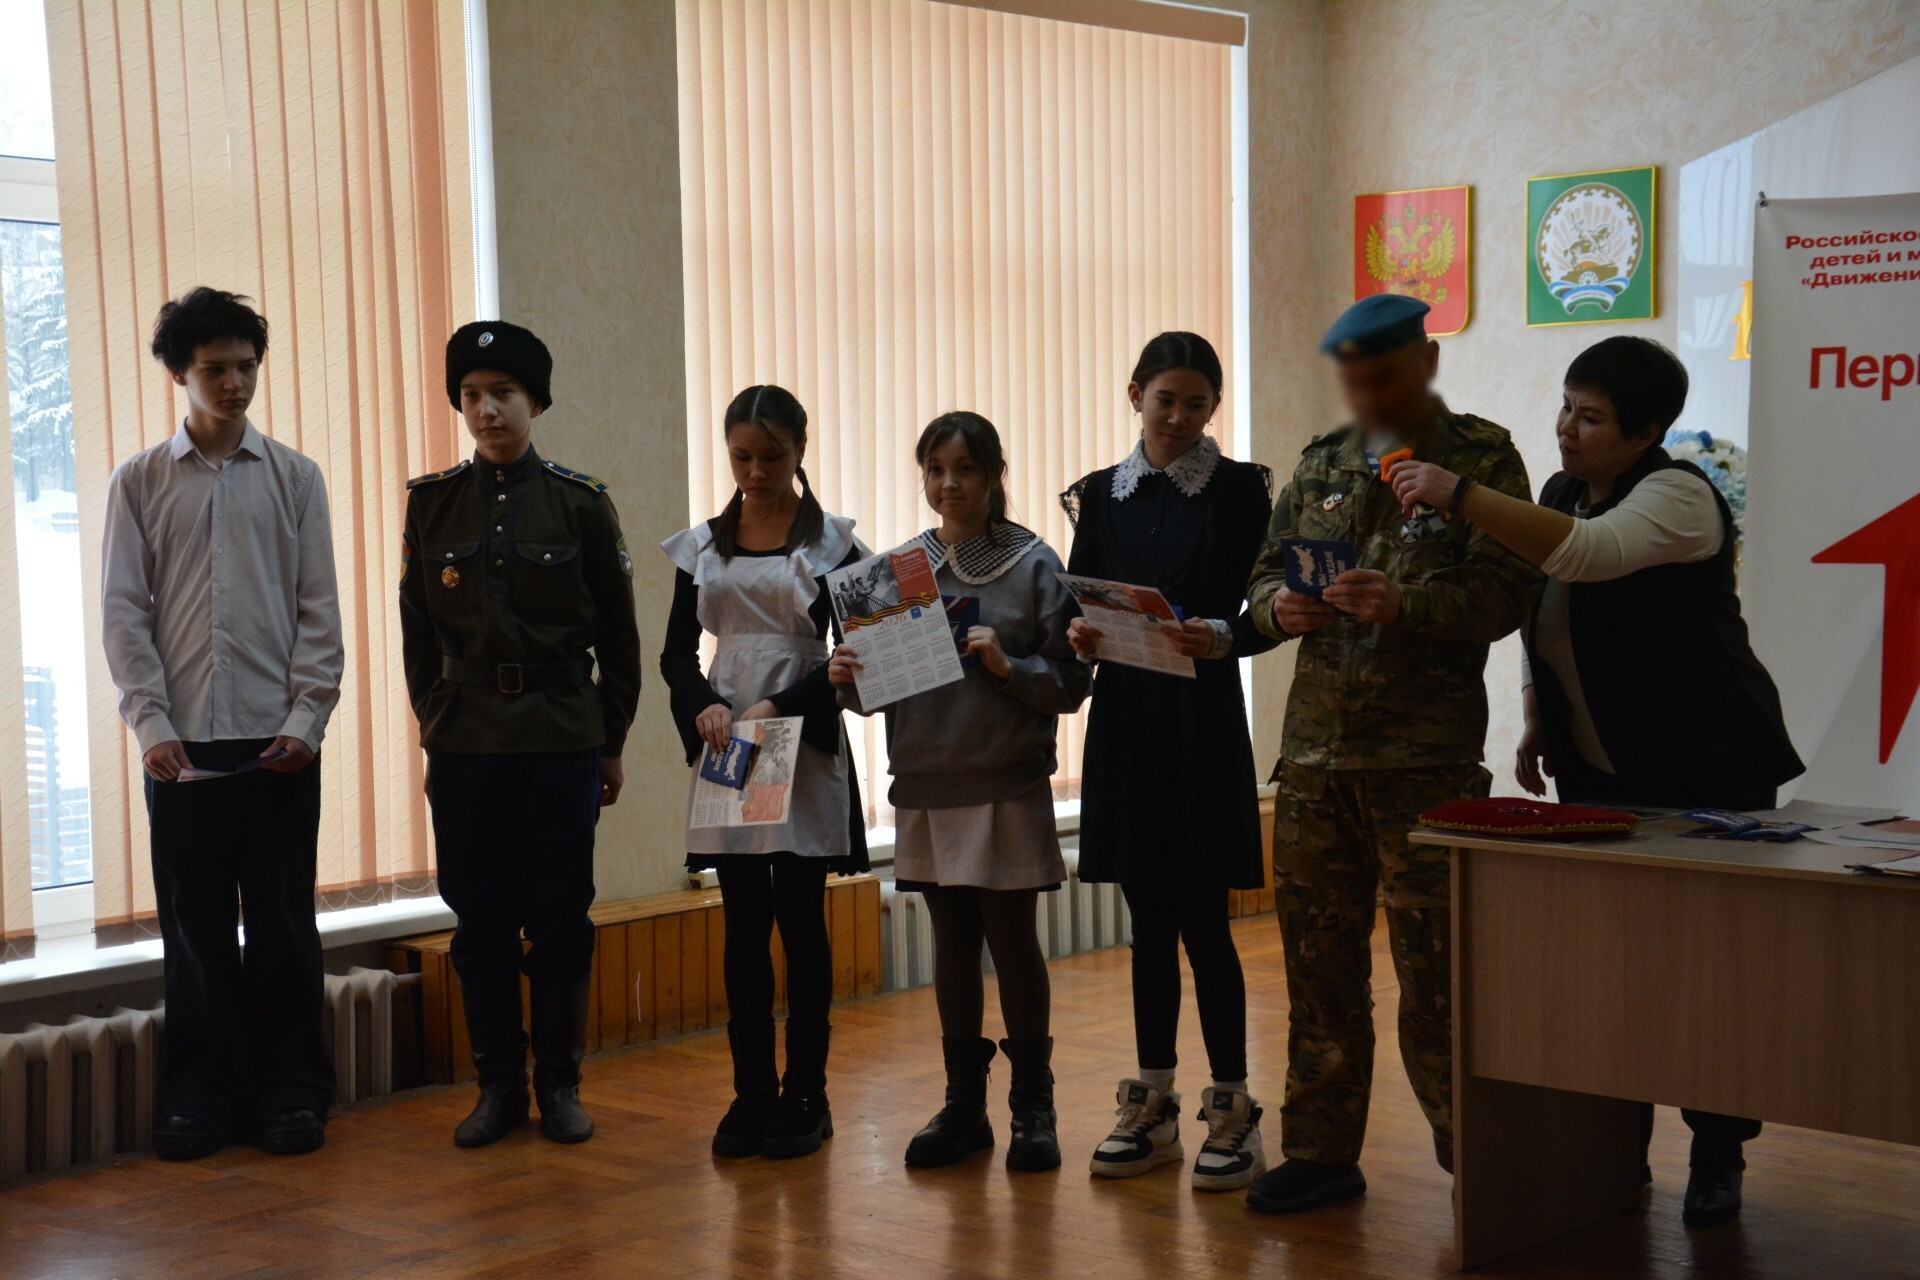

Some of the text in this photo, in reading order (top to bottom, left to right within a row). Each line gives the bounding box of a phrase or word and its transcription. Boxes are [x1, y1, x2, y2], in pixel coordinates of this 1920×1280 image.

[1786, 230, 1920, 249] Российско
[1810, 249, 1882, 270] детей
[1887, 250, 1902, 262] и
[1801, 269, 1920, 289] «Движени
[1809, 346, 1920, 401] Пер
